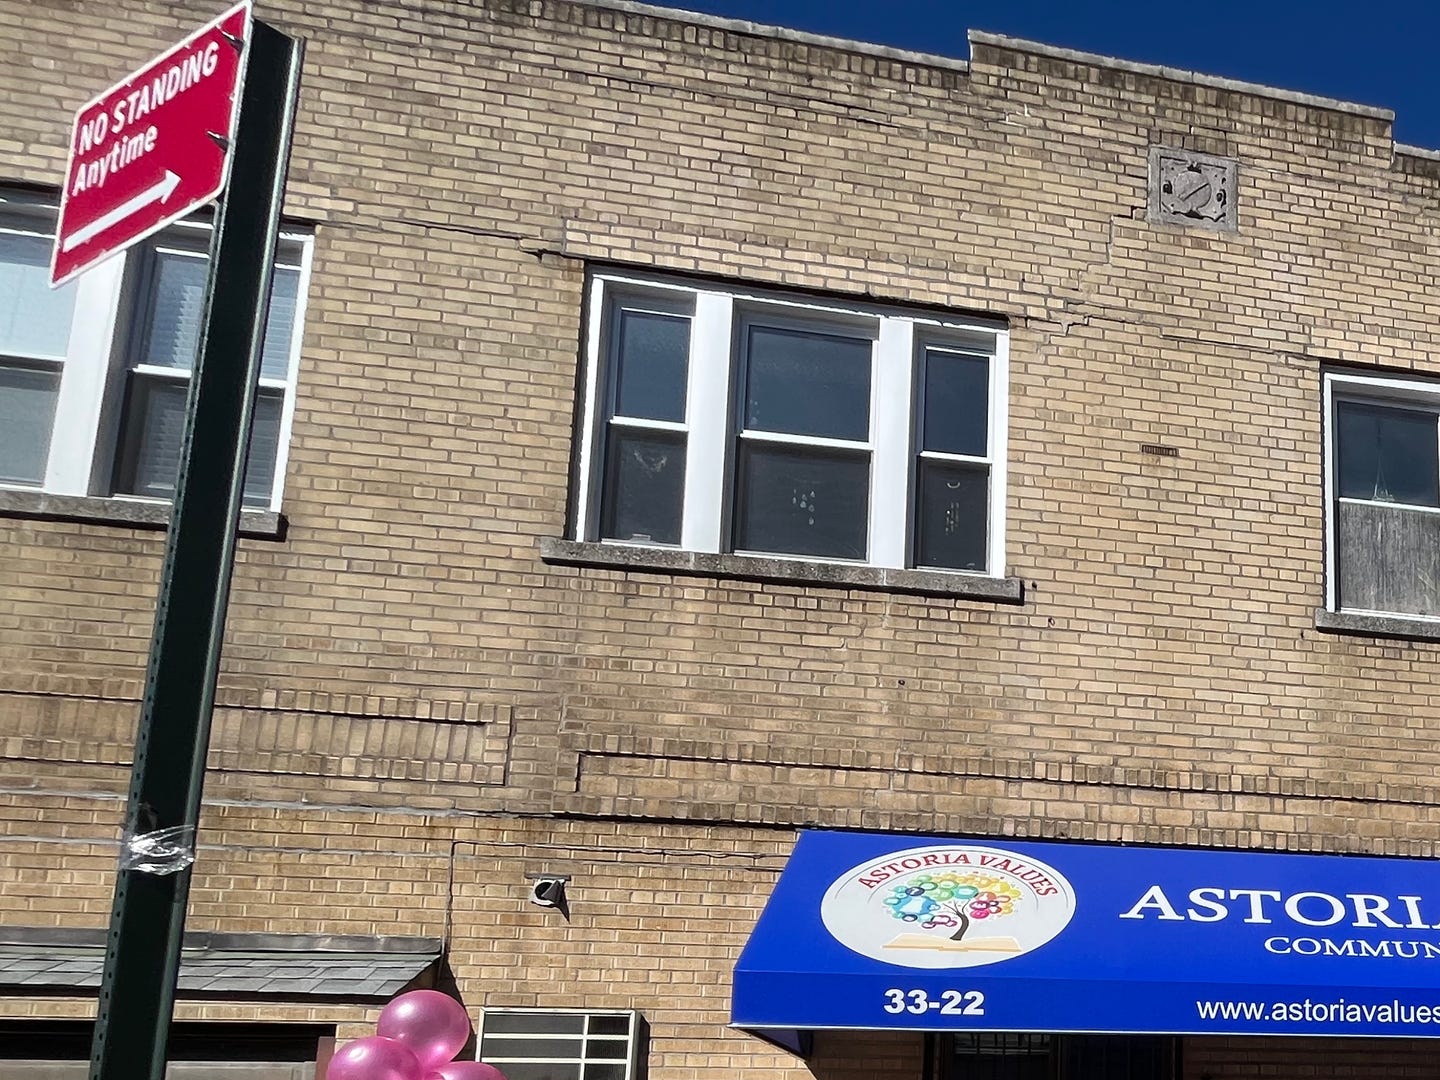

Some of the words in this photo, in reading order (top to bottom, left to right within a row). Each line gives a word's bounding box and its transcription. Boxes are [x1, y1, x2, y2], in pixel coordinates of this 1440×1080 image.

[78, 112, 109, 155] NO
[111, 41, 220, 134] STANDING
[72, 125, 158, 196] Anytime
[858, 853, 971, 890] ASTORIA
[979, 854, 1059, 898] VALUES
[883, 988, 985, 1016] 33-22
